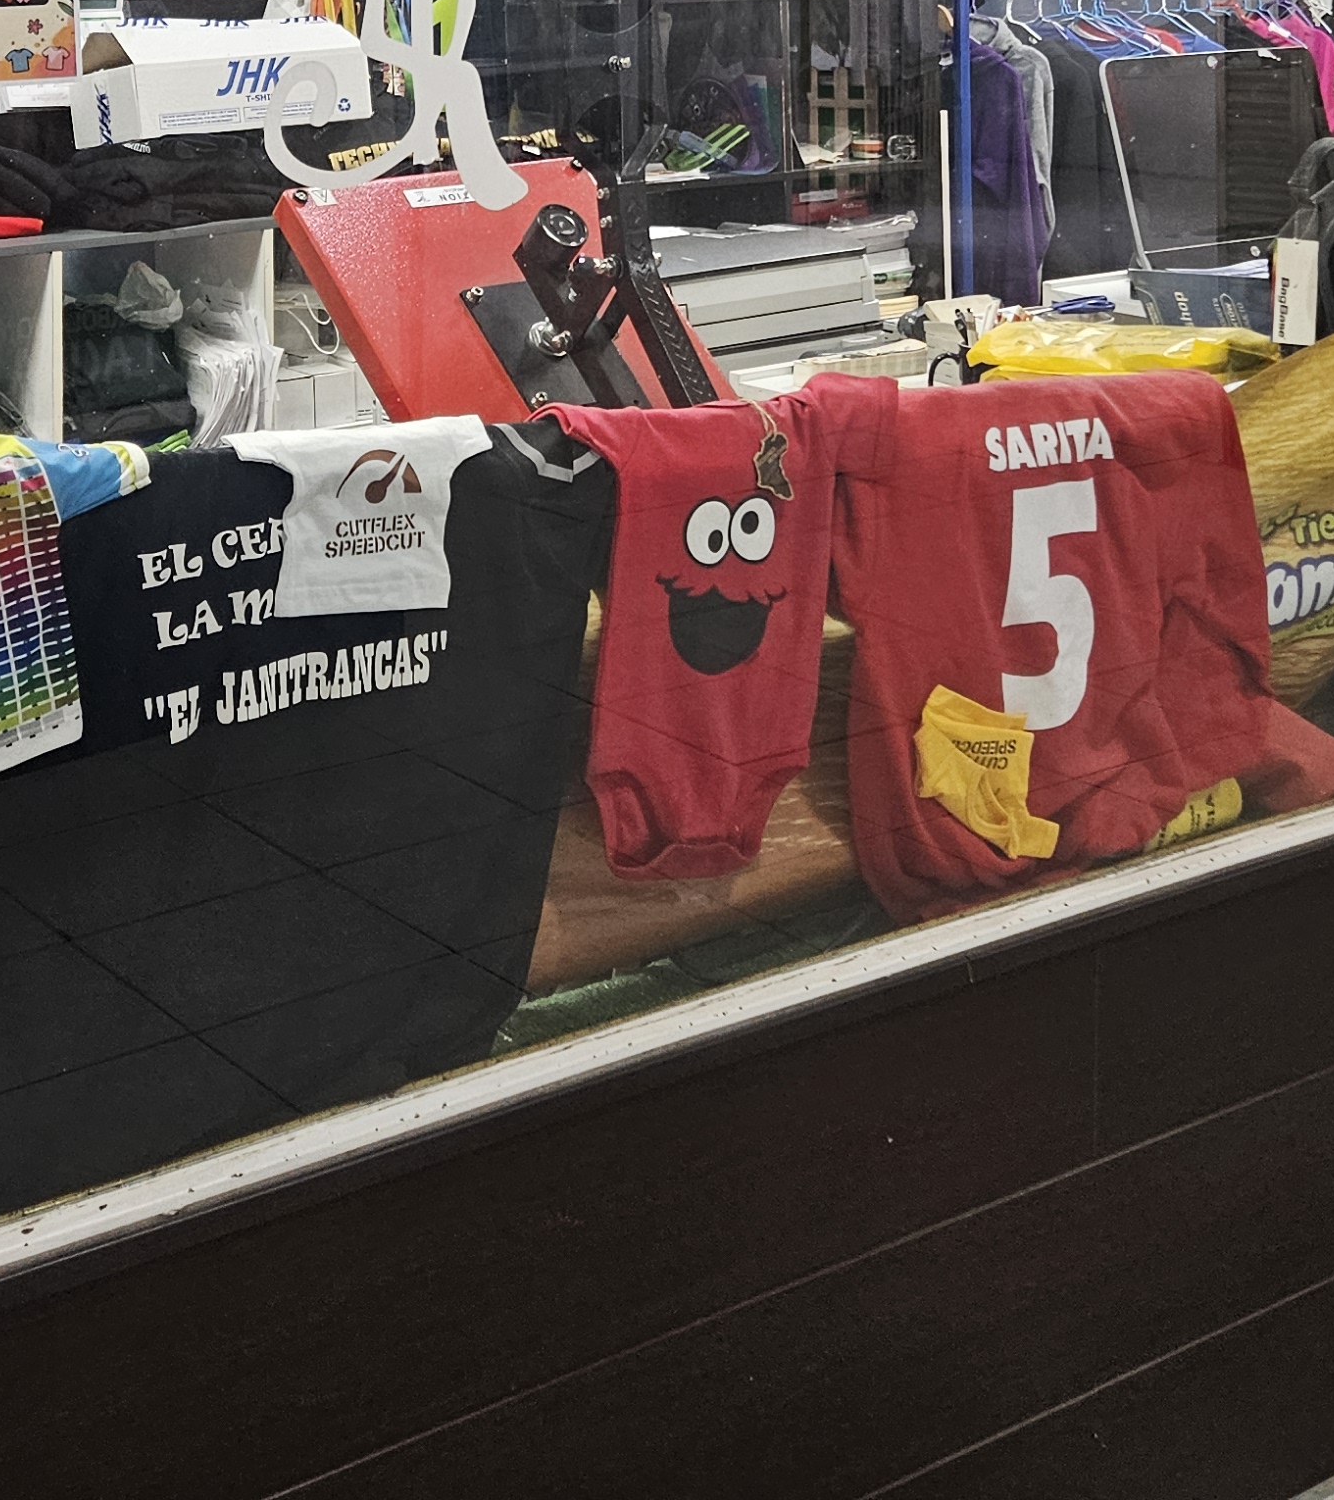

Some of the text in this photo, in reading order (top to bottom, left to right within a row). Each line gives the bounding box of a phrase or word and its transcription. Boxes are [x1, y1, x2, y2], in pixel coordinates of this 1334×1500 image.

[215, 55, 292, 97] JHK
[985, 417, 1114, 472] SARITA
[324, 531, 426, 558] SPEEDCUT
[335, 513, 416, 538] CUTFLEX
[136, 543, 204, 590] EL
[152, 600, 223, 650] LA
[1001, 477, 1098, 731] 5
[143, 630, 448, 745] "EL JANITRANCAS"
